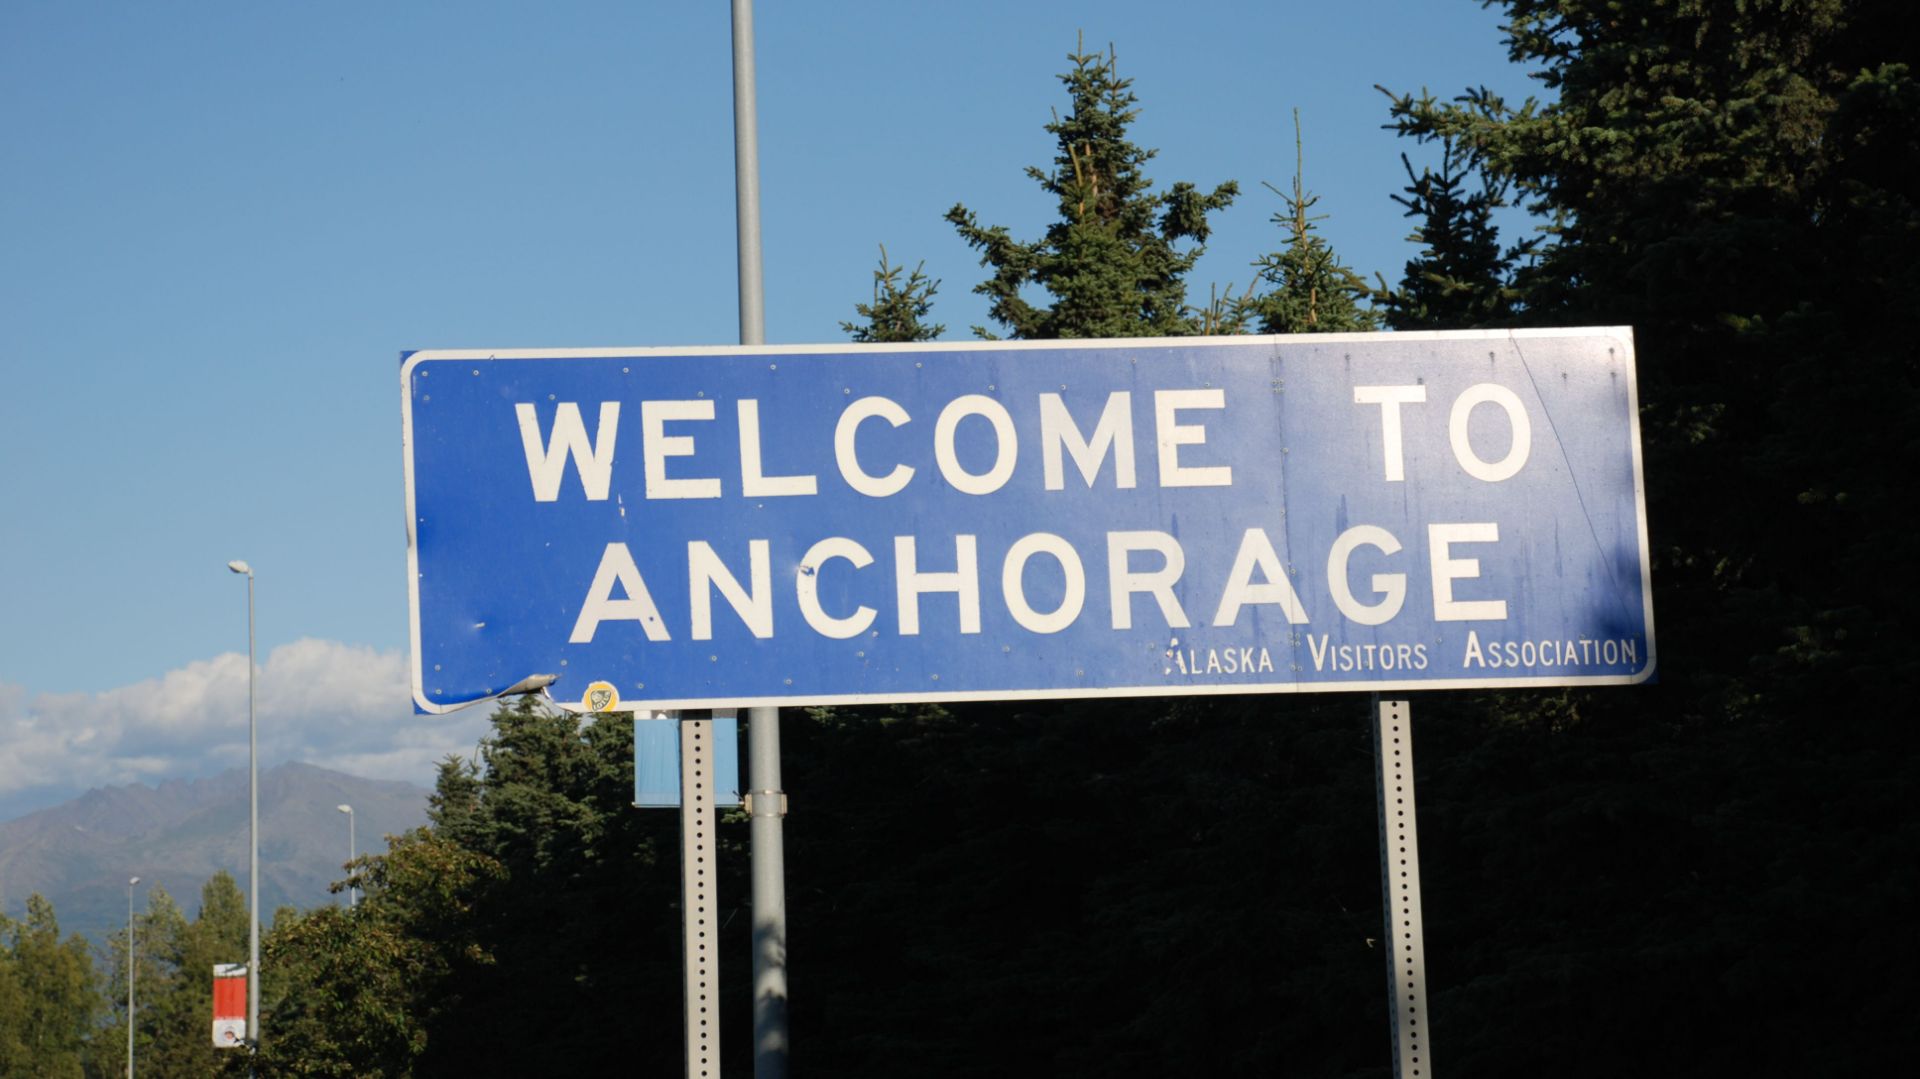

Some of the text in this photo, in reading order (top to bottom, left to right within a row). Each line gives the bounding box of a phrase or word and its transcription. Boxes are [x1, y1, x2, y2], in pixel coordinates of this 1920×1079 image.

[515, 383, 1533, 502] WELCOME TO
[569, 521, 1509, 644] ANCHORAGE
[1165, 630, 1637, 675] ALASKA VISITORS ASSOCIATION
